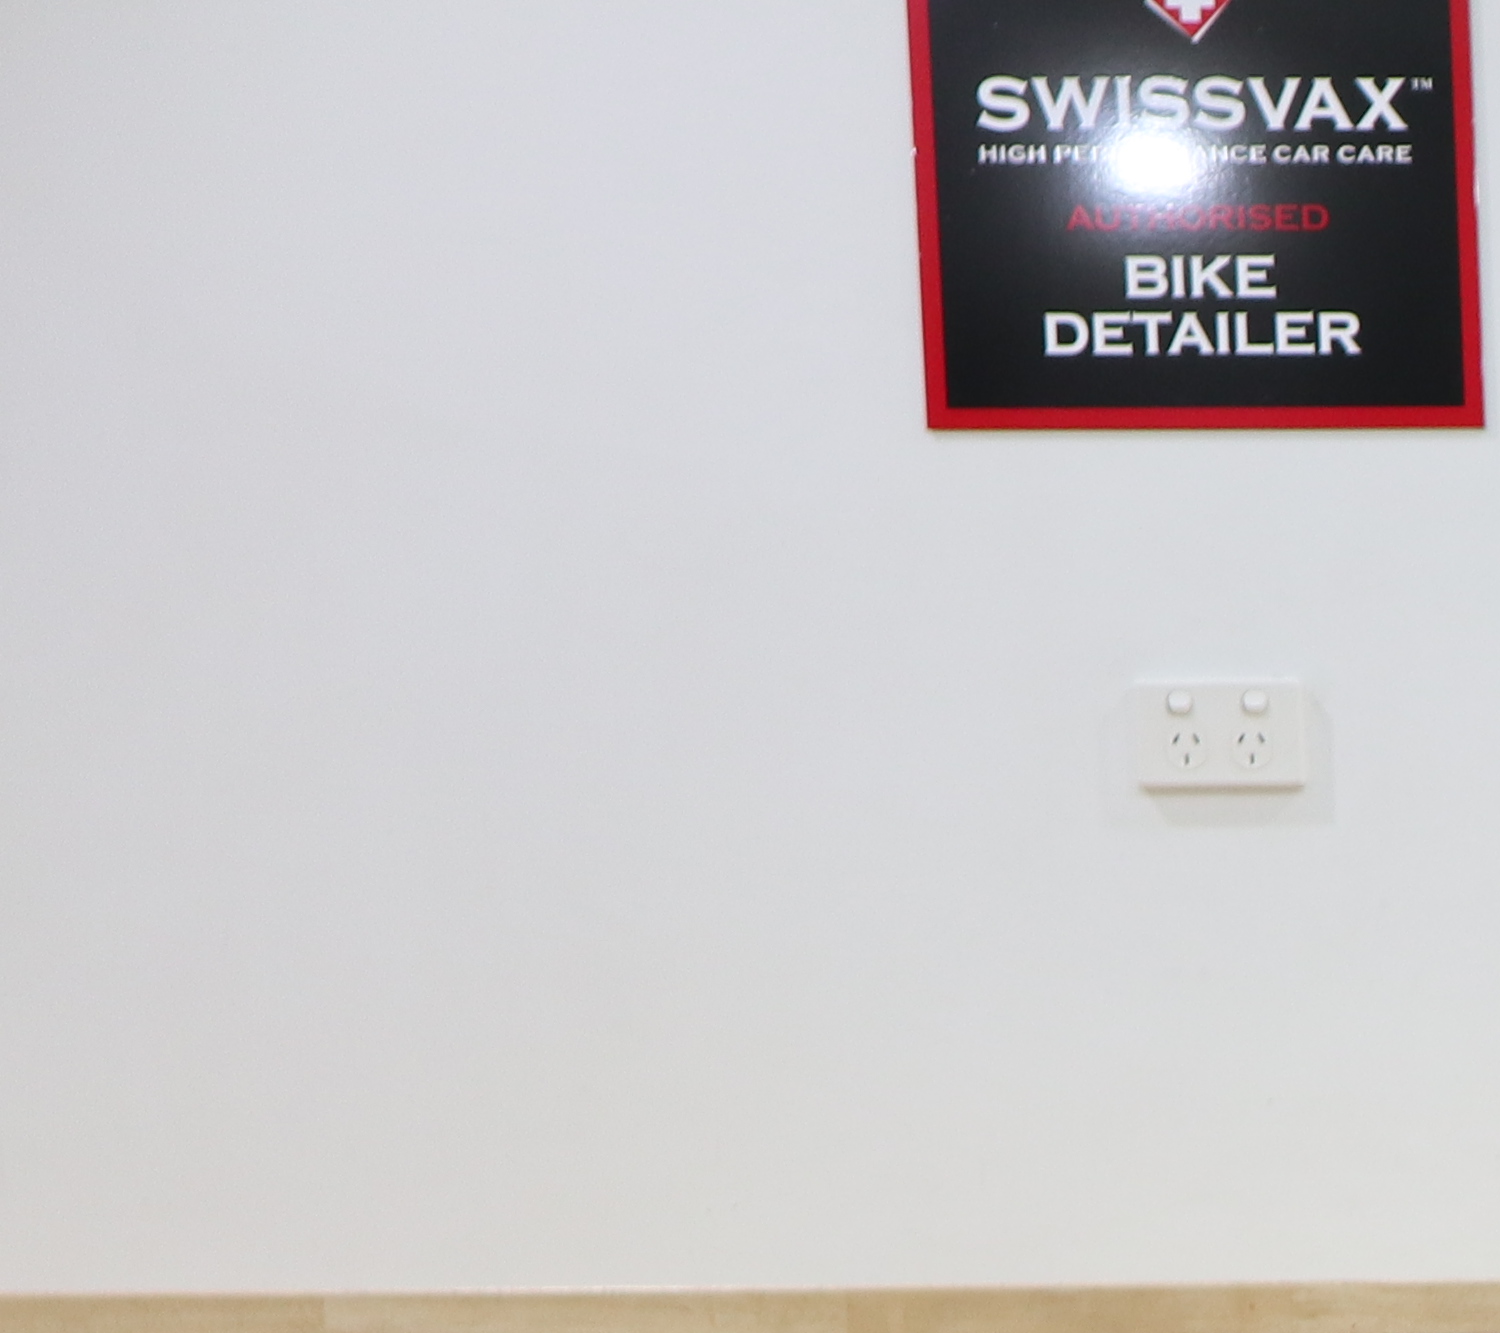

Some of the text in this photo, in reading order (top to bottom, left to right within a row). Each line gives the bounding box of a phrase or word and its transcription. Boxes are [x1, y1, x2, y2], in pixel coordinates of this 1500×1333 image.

[977, 143, 1046, 165] HIGH
[1272, 143, 1332, 164] CAR
[1337, 143, 1413, 164] CARE
[1066, 203, 1331, 232] AUTHORISED
[1124, 254, 1277, 299] BIKE
[1043, 311, 1362, 357] DETAILER
